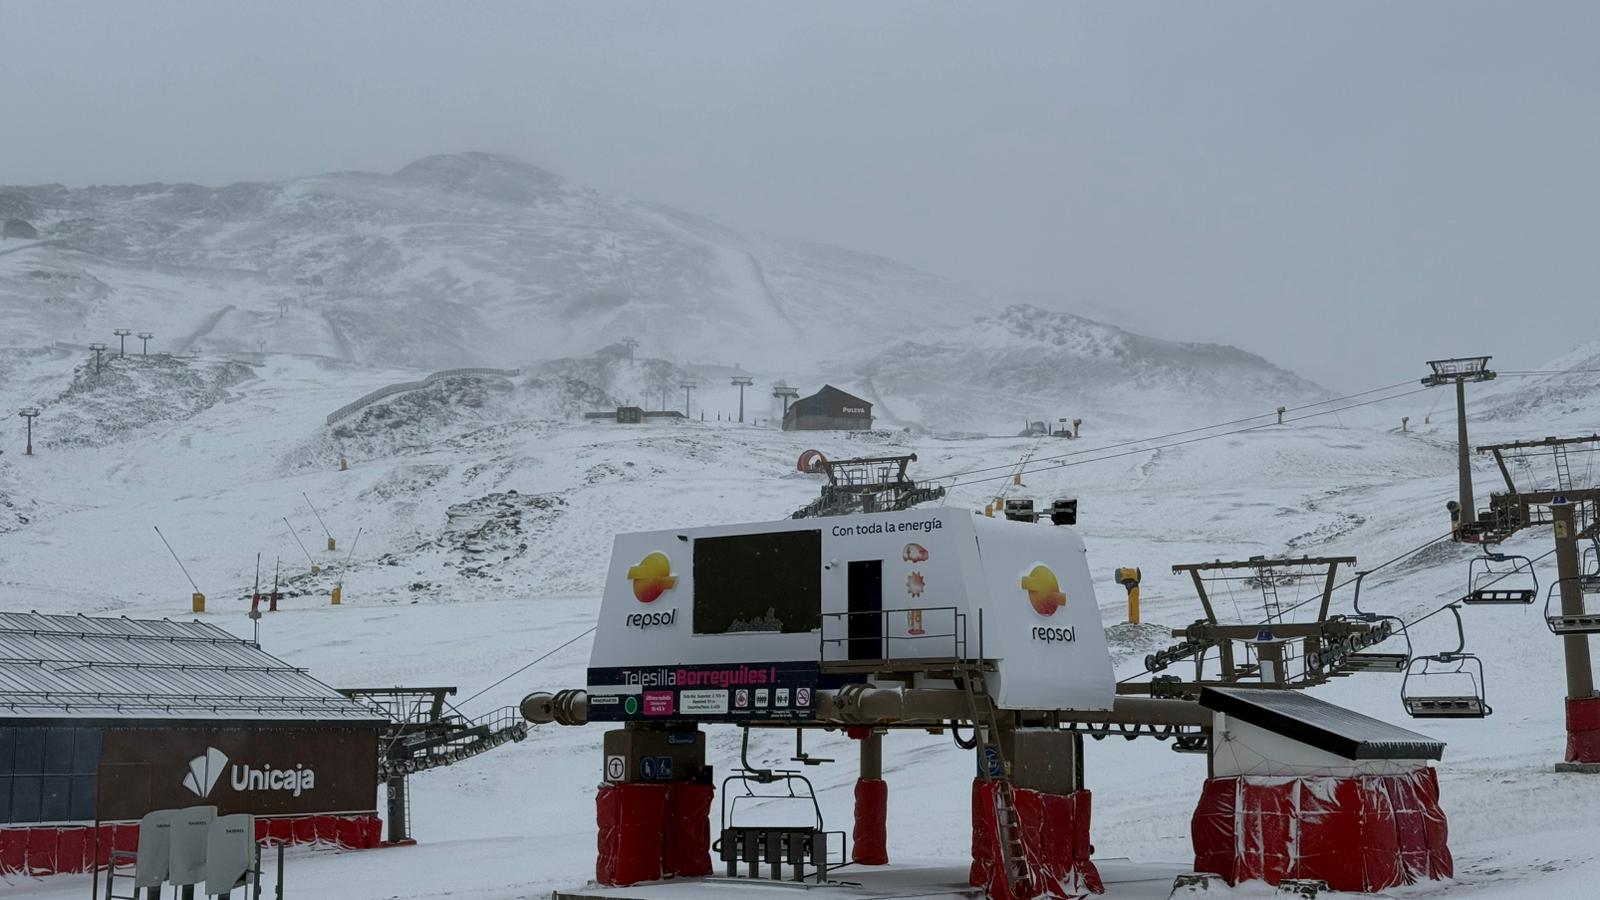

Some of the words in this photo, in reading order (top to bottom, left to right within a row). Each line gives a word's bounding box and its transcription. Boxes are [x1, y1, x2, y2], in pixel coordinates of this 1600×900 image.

[832, 525, 854, 537] Con
[856, 523, 883, 535] toda
[885, 521, 896, 533] la
[898, 517, 943, 533] energía
[625, 608, 676, 630] repsol
[1032, 625, 1076, 645] repsol
[230, 763, 315, 797] Unicaja
